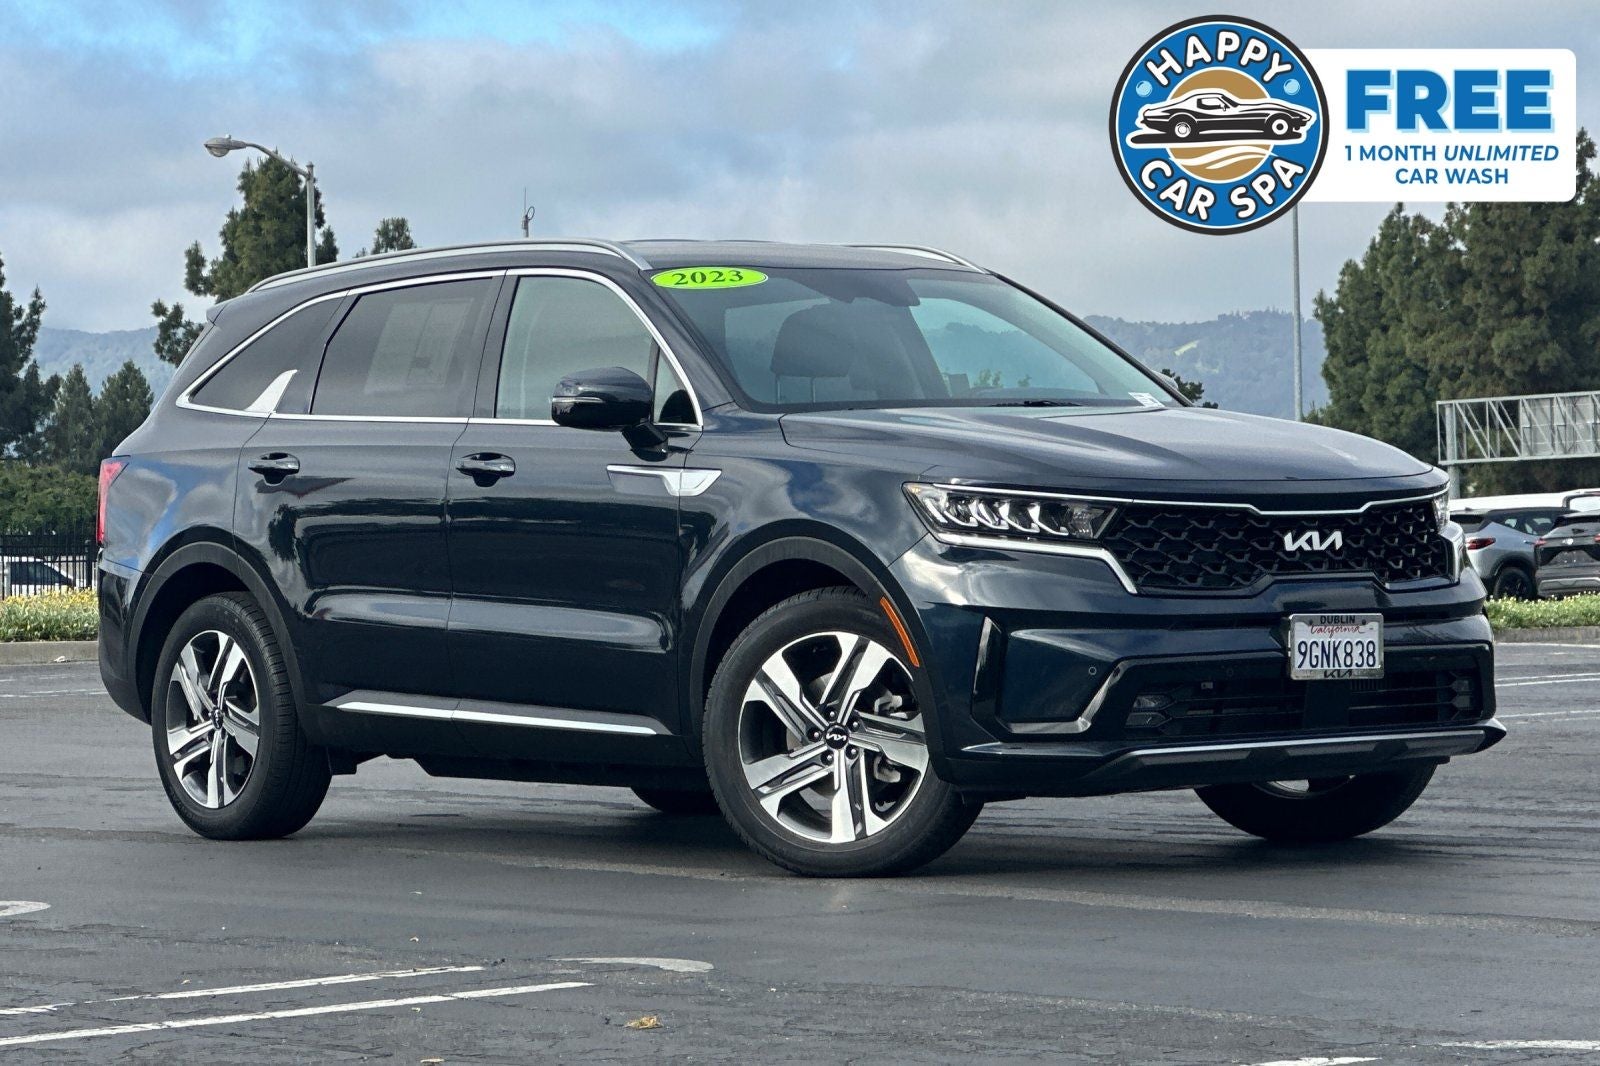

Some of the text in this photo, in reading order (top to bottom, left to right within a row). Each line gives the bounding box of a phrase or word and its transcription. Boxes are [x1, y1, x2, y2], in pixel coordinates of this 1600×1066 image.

[671, 270, 744, 286] 2023
[1284, 530, 1343, 551] KIA
[1320, 615, 1356, 625] DUBLIN
[1310, 625, 1365, 638] California
[1297, 640, 1377, 668] 9GNK838
[1323, 669, 1352, 679] KIA
